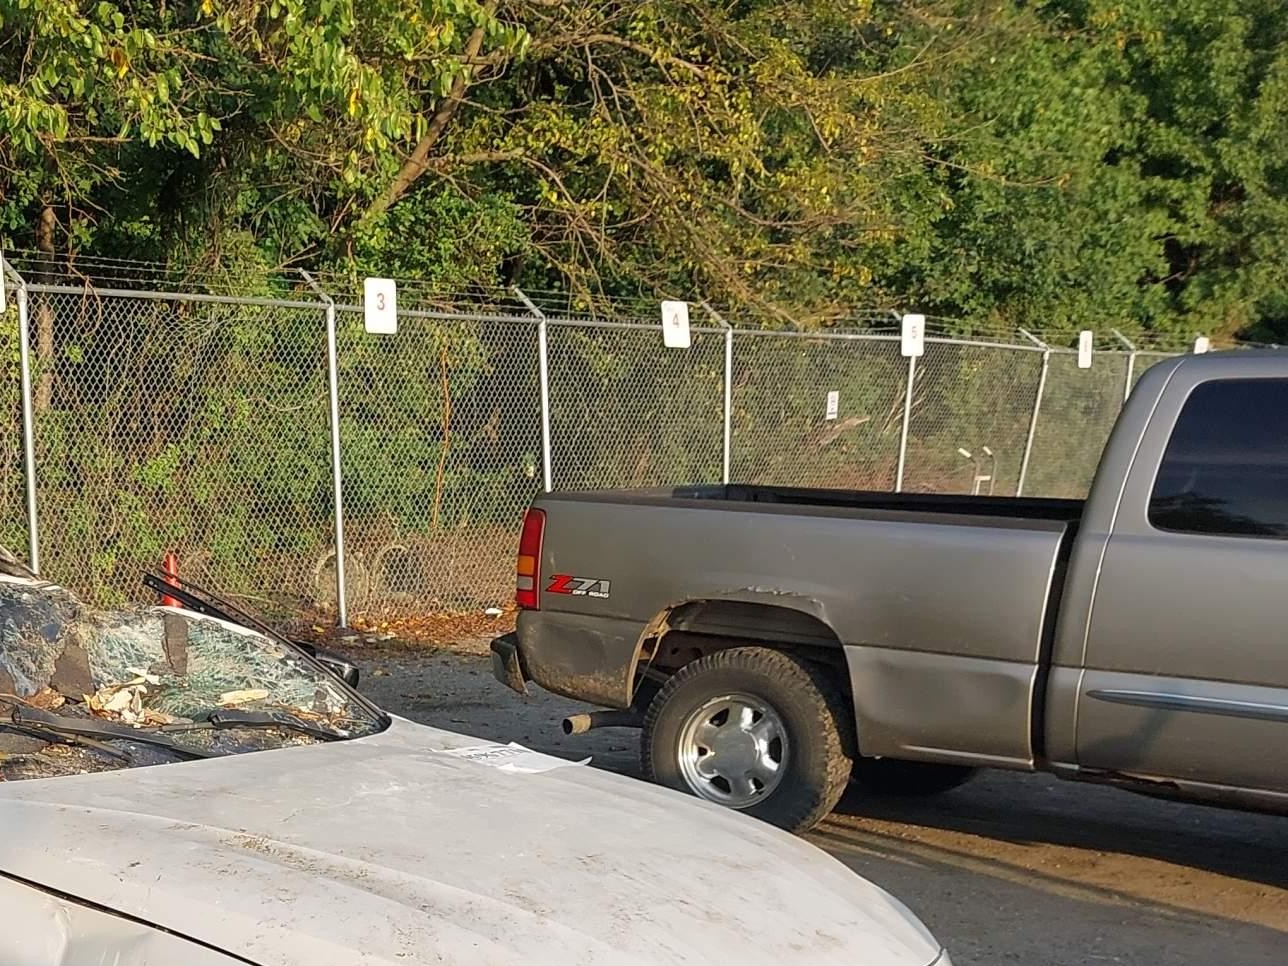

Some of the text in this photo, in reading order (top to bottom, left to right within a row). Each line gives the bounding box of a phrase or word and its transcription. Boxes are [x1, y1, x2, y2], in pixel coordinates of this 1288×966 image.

[376, 292, 385, 311] 3
[672, 312, 680, 329] 4
[545, 574, 611, 594] Z71
[588, 591, 610, 599] ROAD
